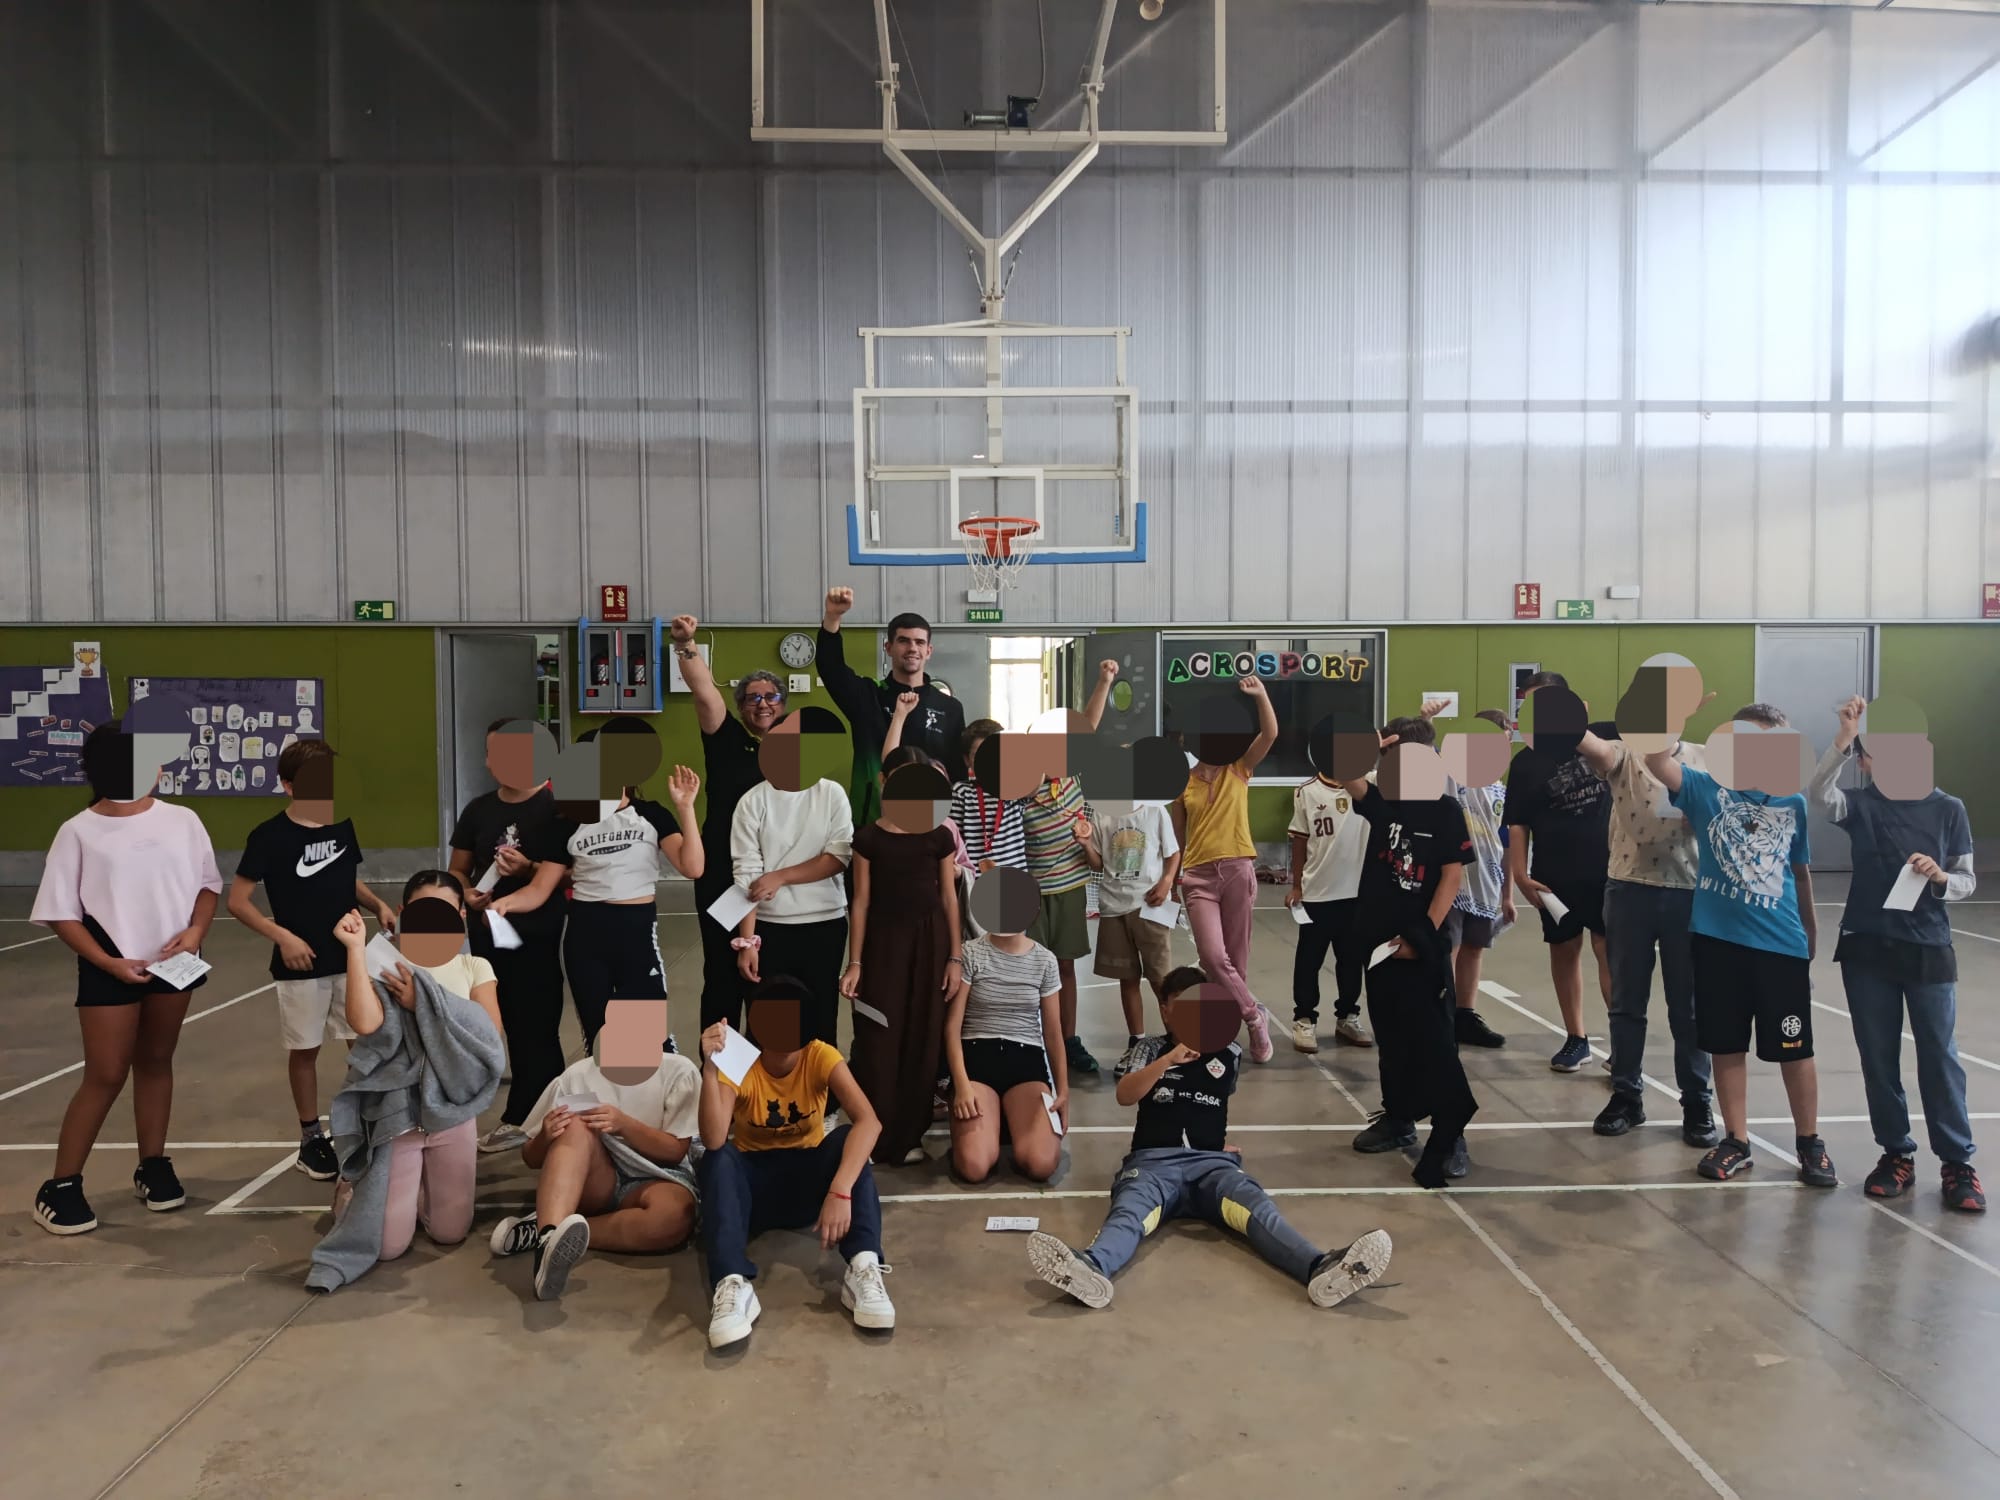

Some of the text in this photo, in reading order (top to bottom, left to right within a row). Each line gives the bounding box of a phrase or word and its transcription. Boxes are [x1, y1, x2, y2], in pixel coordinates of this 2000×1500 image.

[970, 611, 1000, 620] SALIDA
[1168, 652, 1369, 682] ACROSPORT
[1313, 816, 1335, 838] 20
[303, 839, 337, 862] NIKE
[576, 829, 645, 851] CALIFORNIA
[1699, 876, 1739, 899] WILD
[1194, 1091, 1220, 1107] CASA
